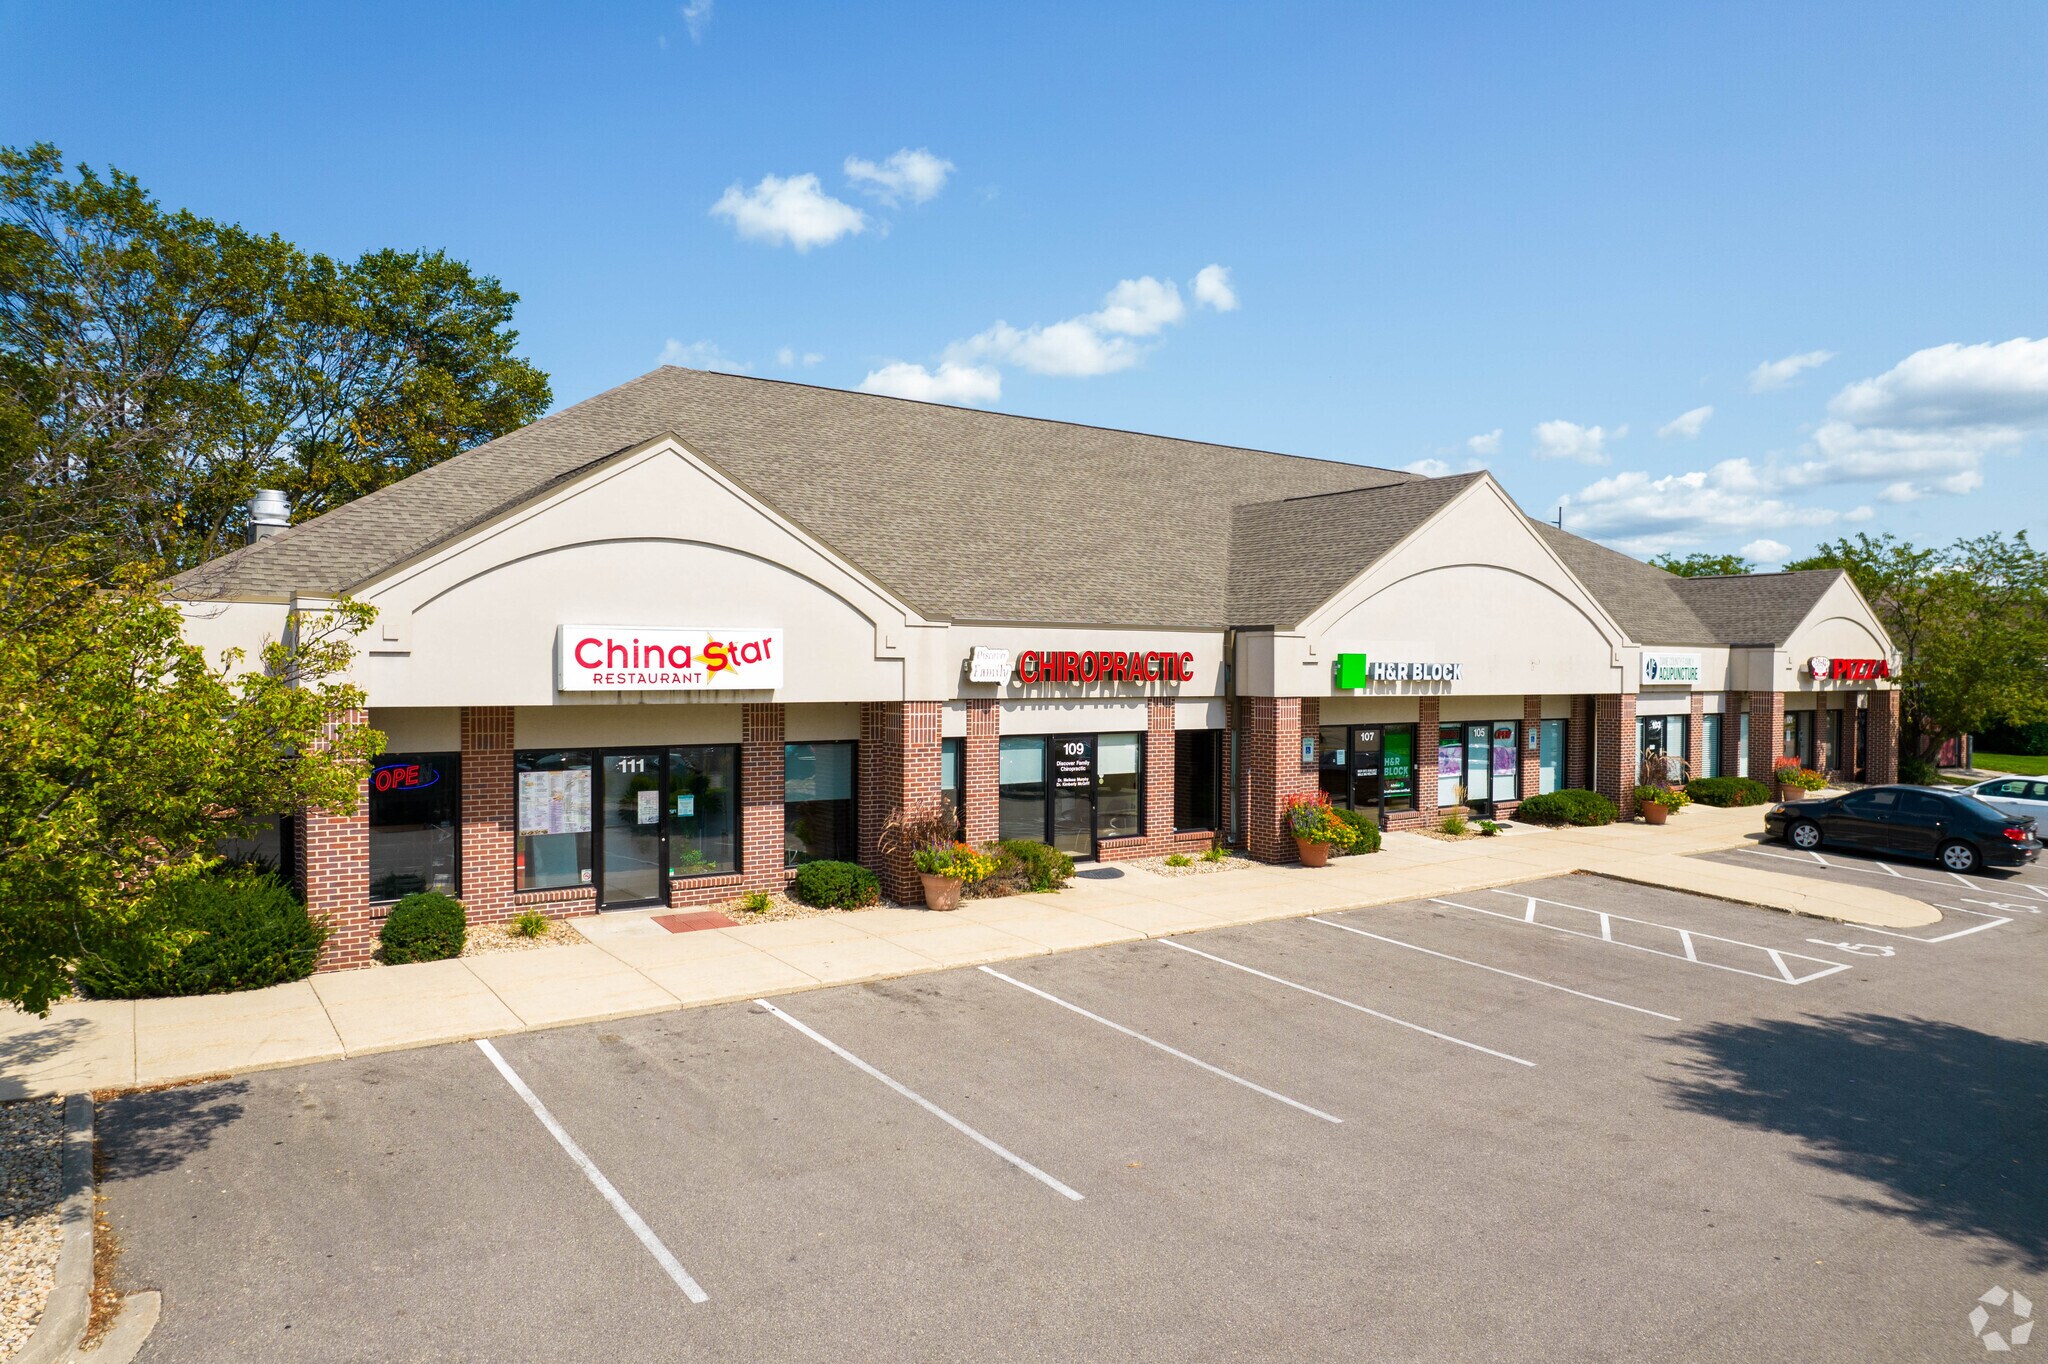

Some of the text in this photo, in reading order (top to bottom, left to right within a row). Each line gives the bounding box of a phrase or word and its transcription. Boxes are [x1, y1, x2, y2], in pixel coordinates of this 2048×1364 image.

[575, 637, 773, 672] China Star
[973, 663, 1010, 682] Family
[1019, 650, 1194, 683] CHIROPRACTIC
[1374, 662, 1463, 681] H&R BLOCK
[1659, 666, 1699, 681] ACUPUNCTURE
[1832, 659, 1890, 680] PIZZA
[593, 673, 702, 685] RESTAURANT
[1360, 731, 1375, 742] 107
[1473, 728, 1486, 738] 105
[1063, 742, 1084, 755] 109
[618, 758, 645, 774] 111
[1384, 757, 1400, 766] H&R
[1384, 766, 1408, 776] BLOCK
